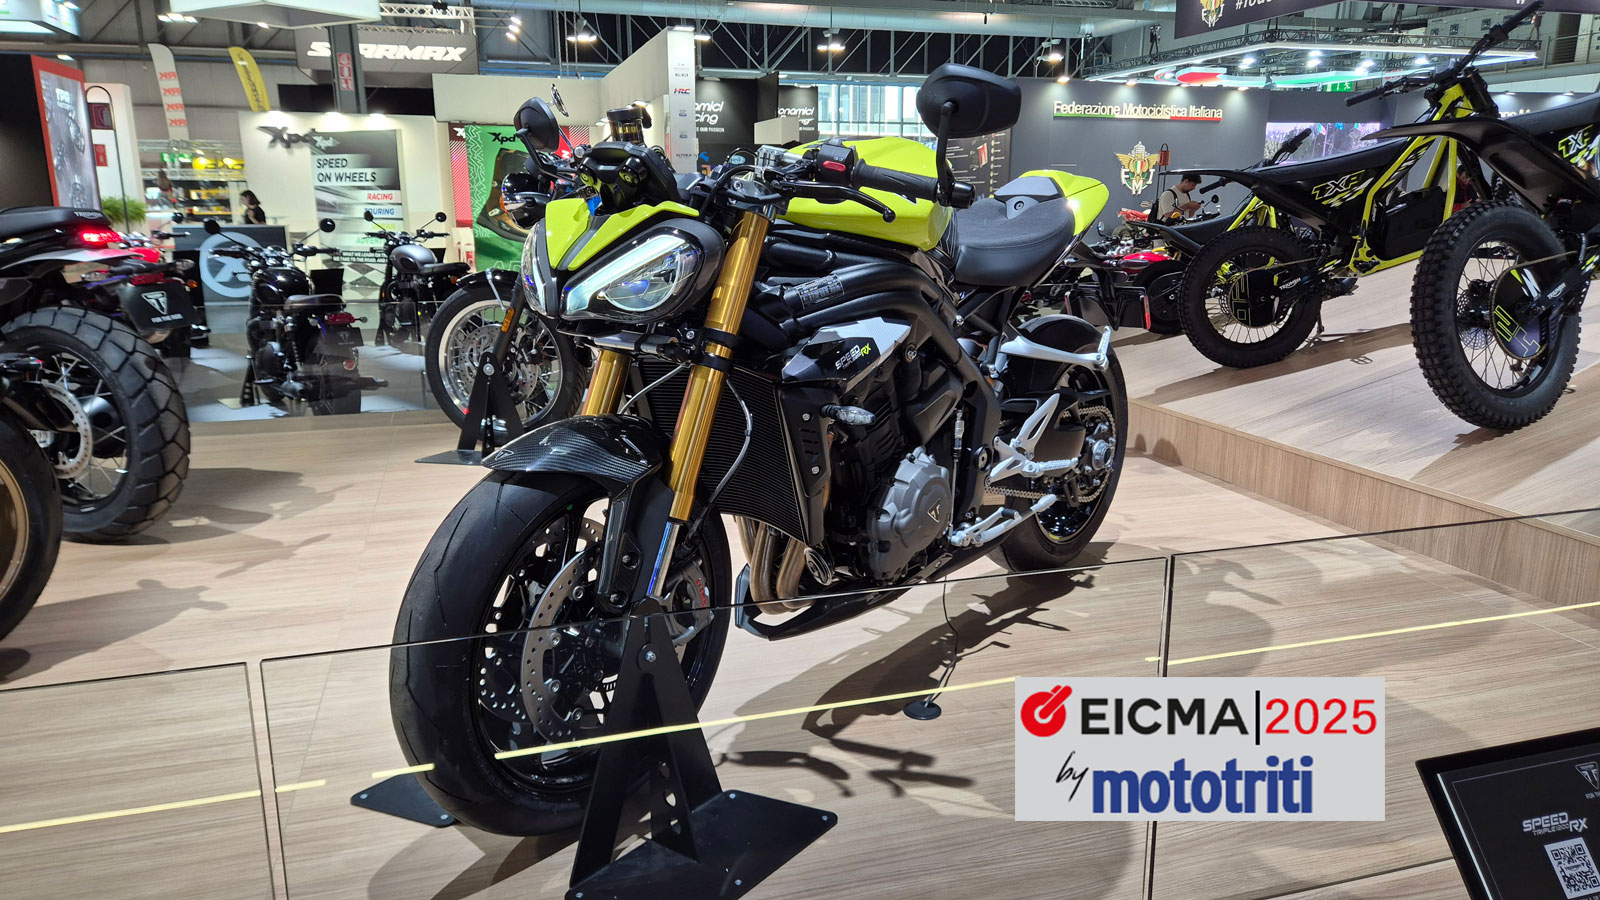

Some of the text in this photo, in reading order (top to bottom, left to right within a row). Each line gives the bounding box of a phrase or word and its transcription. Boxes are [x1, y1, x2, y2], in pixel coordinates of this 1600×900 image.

[307, 42, 467, 61] SARMAX
[777, 106, 815, 116] onamici
[1053, 100, 1223, 118] Federazione Motociclistica Italiana
[695, 111, 719, 125] cing
[488, 132, 516, 144] Xpd
[316, 158, 348, 168] SPEED
[317, 171, 377, 182] ON WHEELS
[1279, 277, 1302, 290] TRIUMPH
[835, 345, 860, 370] SPEED
[861, 343, 871, 357] RX
[1522, 812, 1588, 832] SPEED RX
